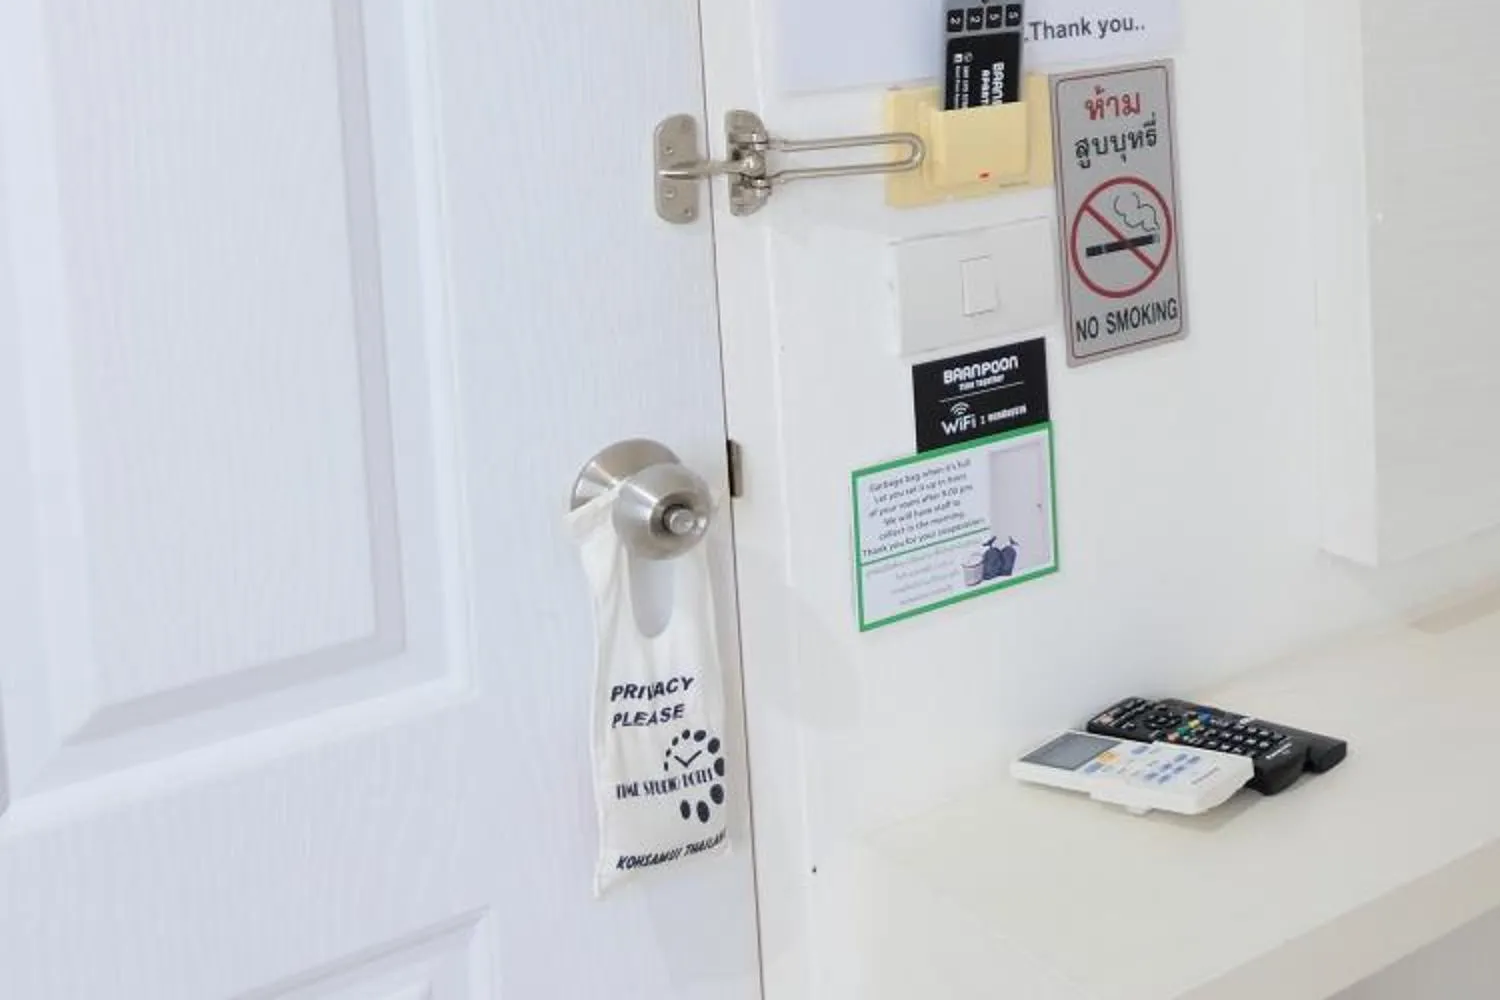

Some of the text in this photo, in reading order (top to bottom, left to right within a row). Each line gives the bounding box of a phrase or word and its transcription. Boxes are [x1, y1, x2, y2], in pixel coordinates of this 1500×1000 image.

[1098, 18, 1145, 40] you..
[1084, 85, 1141, 121] ห้าม
[1076, 297, 1178, 342] NO SMOKING
[610, 676, 695, 702] PRIVACY
[611, 703, 686, 728] PLEASE
